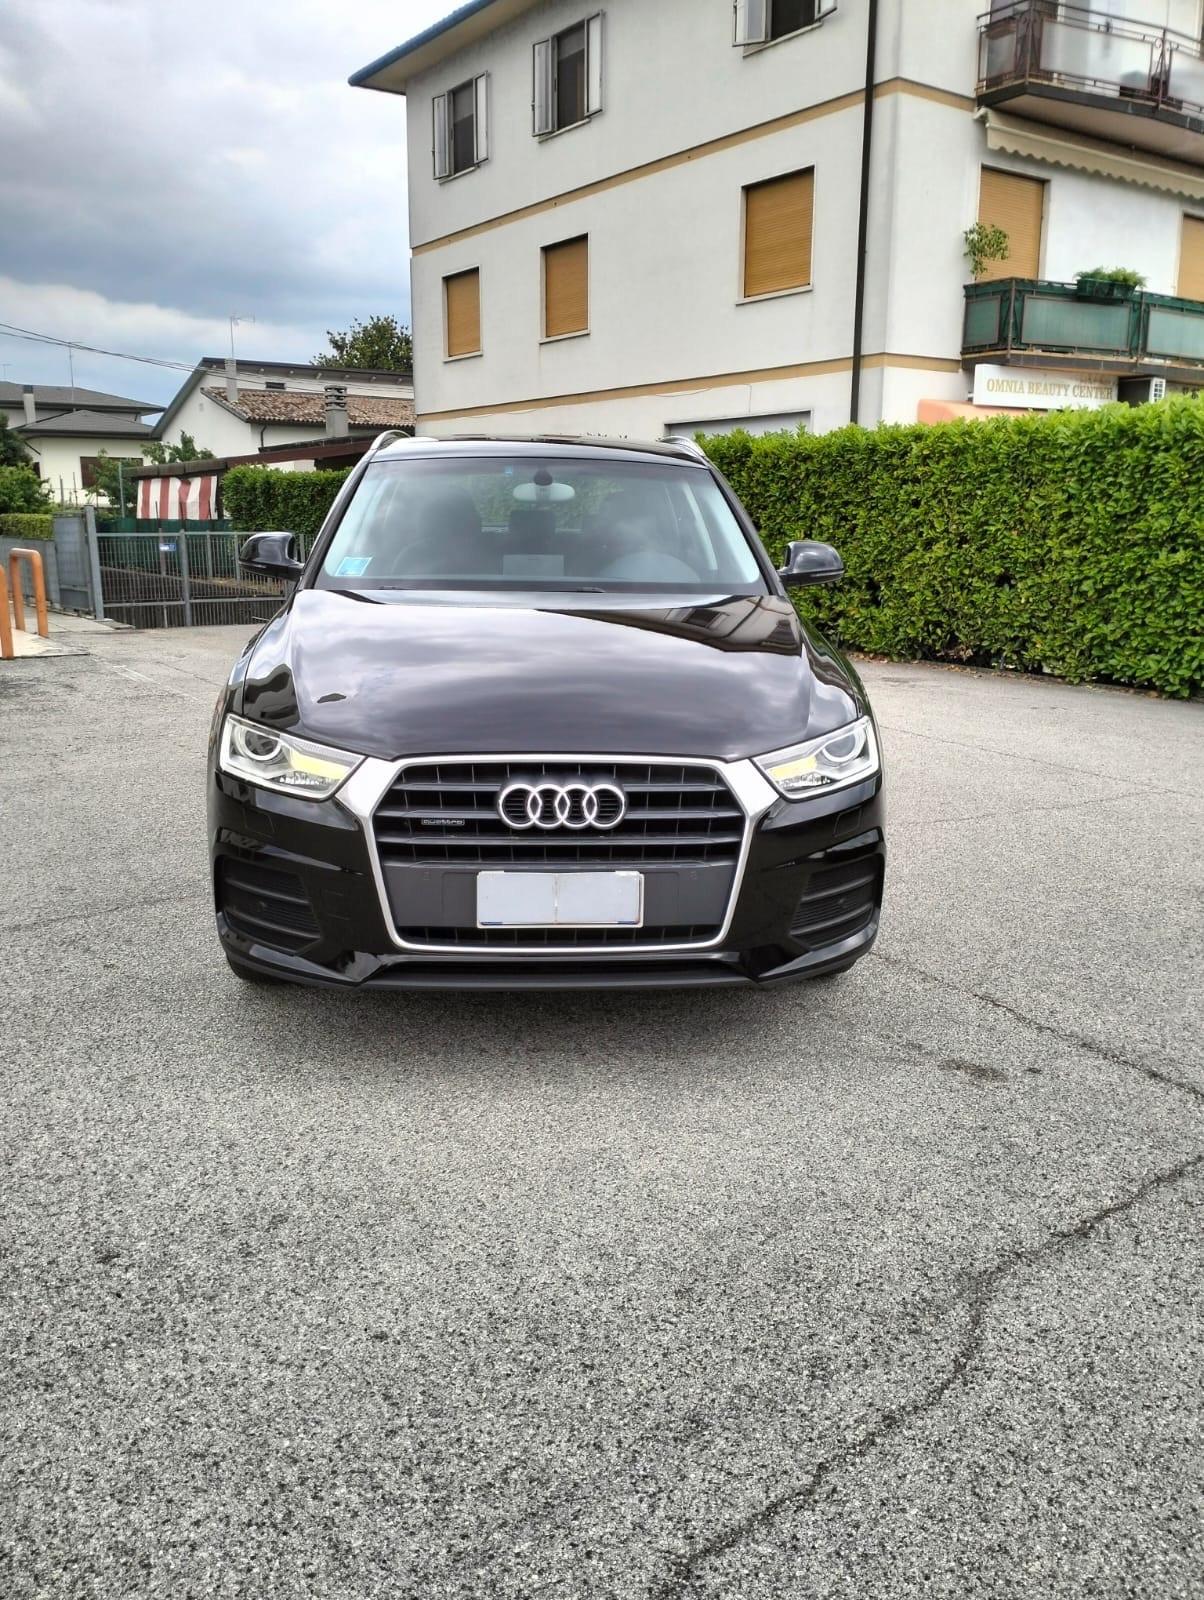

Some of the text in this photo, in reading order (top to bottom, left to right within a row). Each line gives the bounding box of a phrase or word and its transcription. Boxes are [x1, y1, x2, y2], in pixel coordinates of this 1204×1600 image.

[986, 378, 1113, 400] OMNIA BEAUTY CENTER
